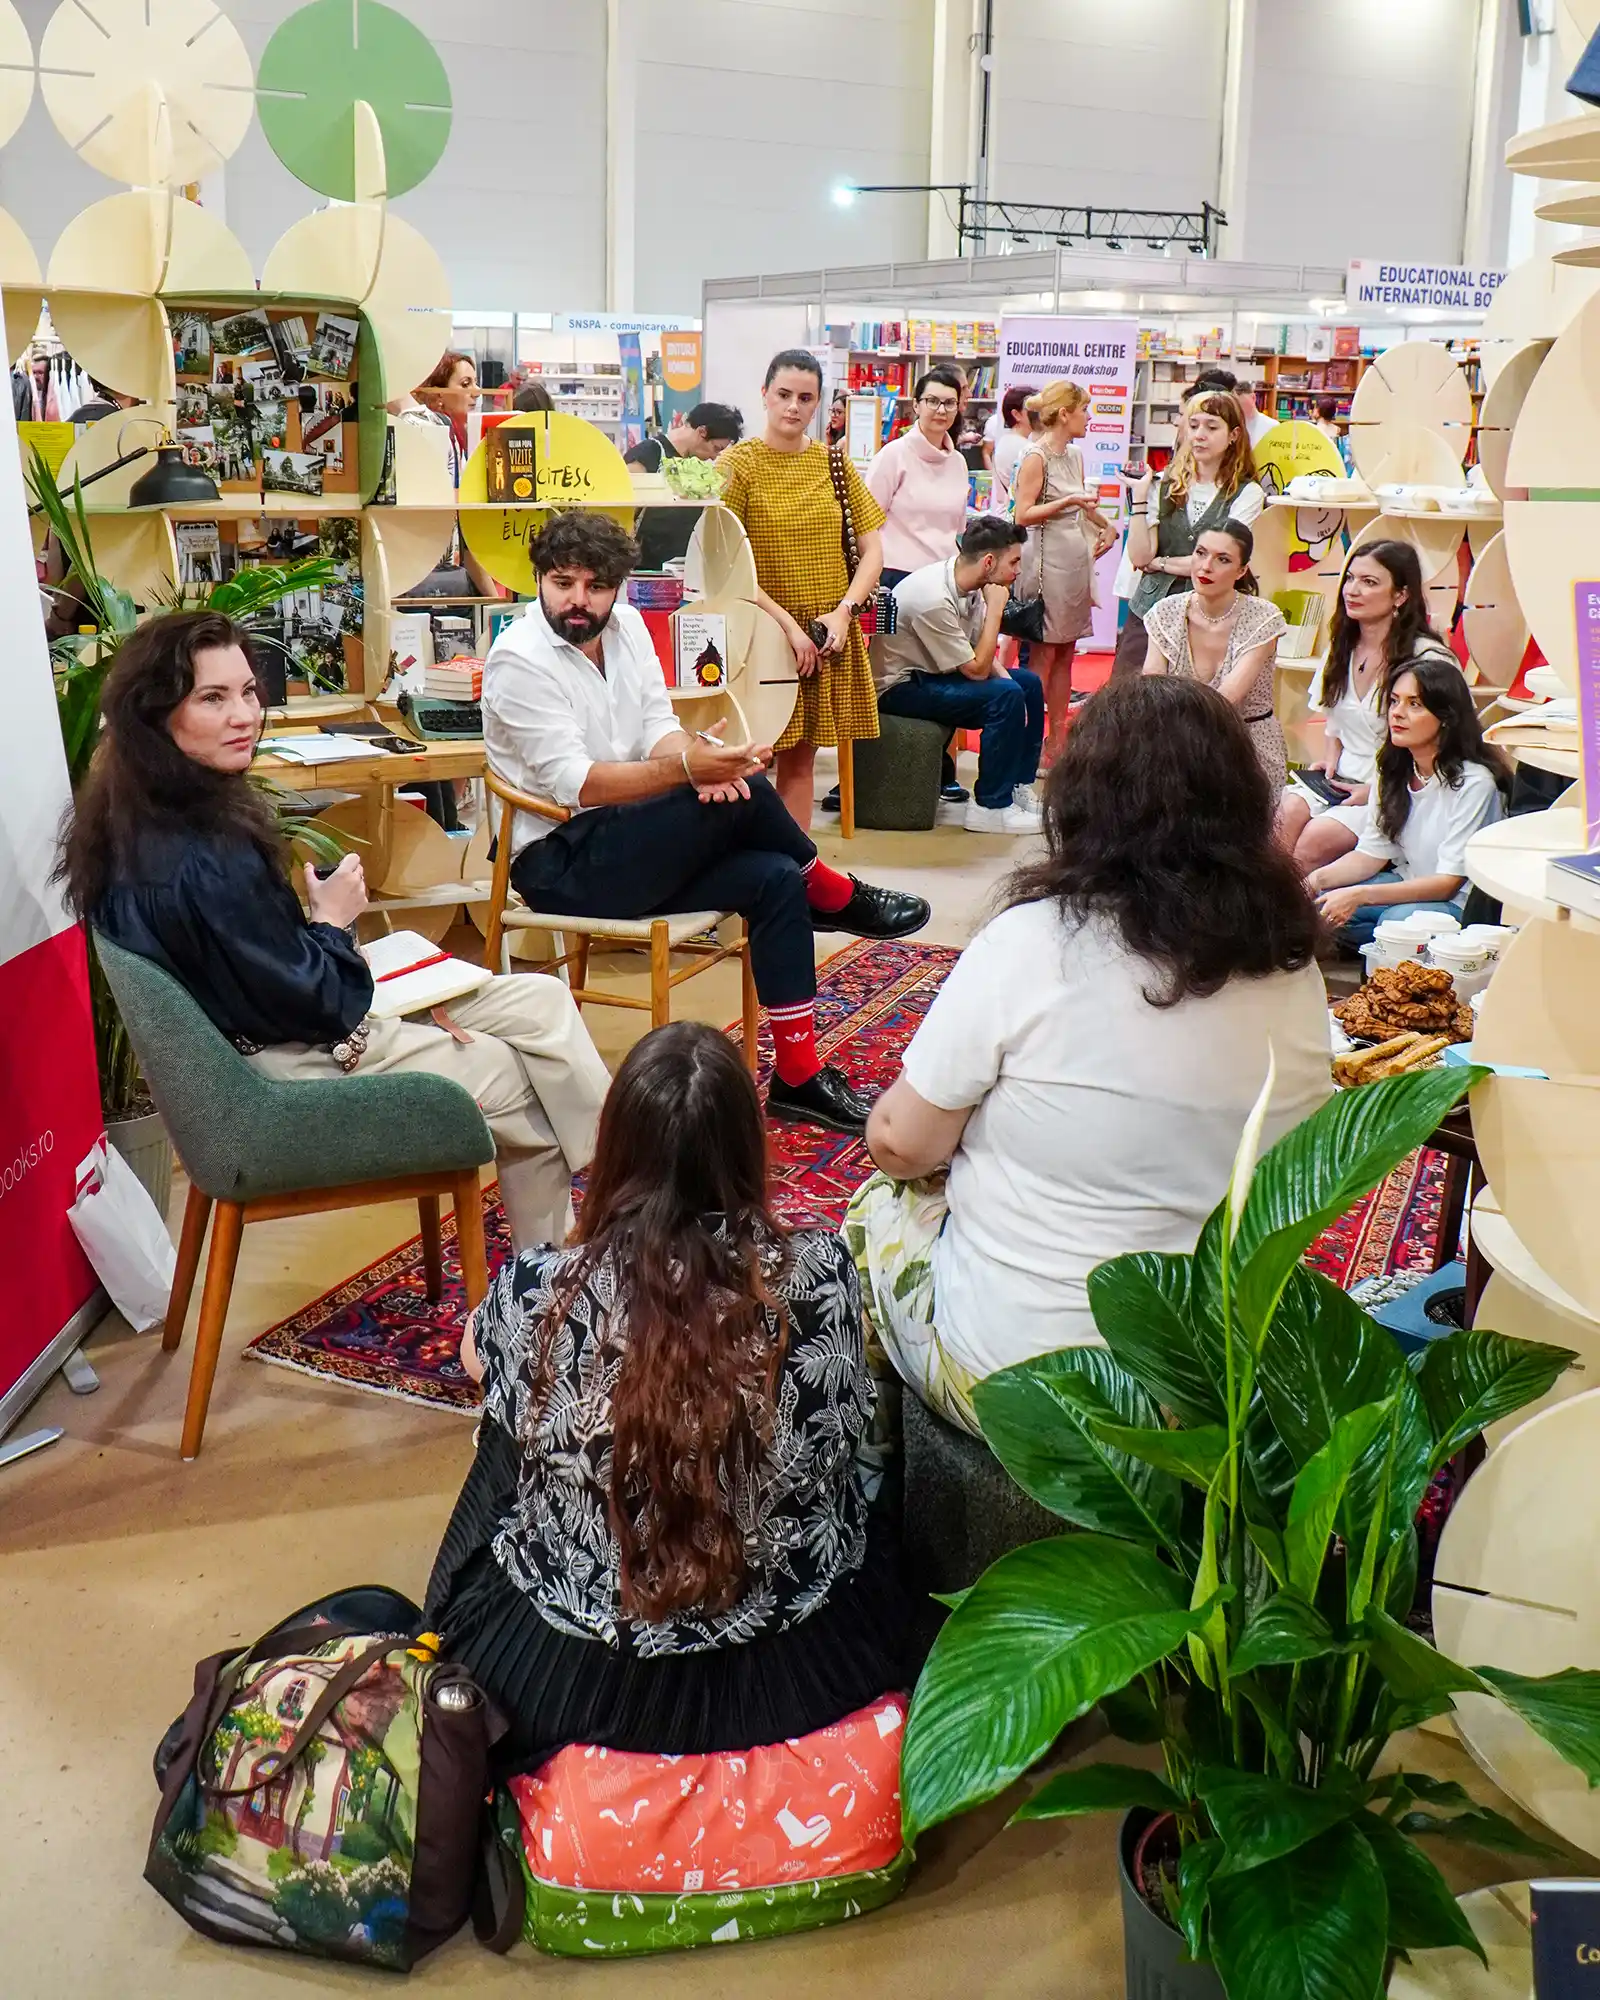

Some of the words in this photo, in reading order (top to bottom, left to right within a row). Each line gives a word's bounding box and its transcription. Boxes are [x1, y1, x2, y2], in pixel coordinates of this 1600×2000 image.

[1379, 266, 1475, 287] EDUCATIONAL
[1359, 285, 1469, 307] INTERNATIONAL
[568, 319, 601, 329] SNSPA
[610, 321, 679, 331] comunicare.ro
[1006, 341, 1080, 357] EDUCATIONAL
[1084, 343, 1126, 359] CENTRE
[1011, 362, 1071, 375] International
[1072, 364, 1119, 377] Bookshop
[508, 448, 532, 465] VIZITE
